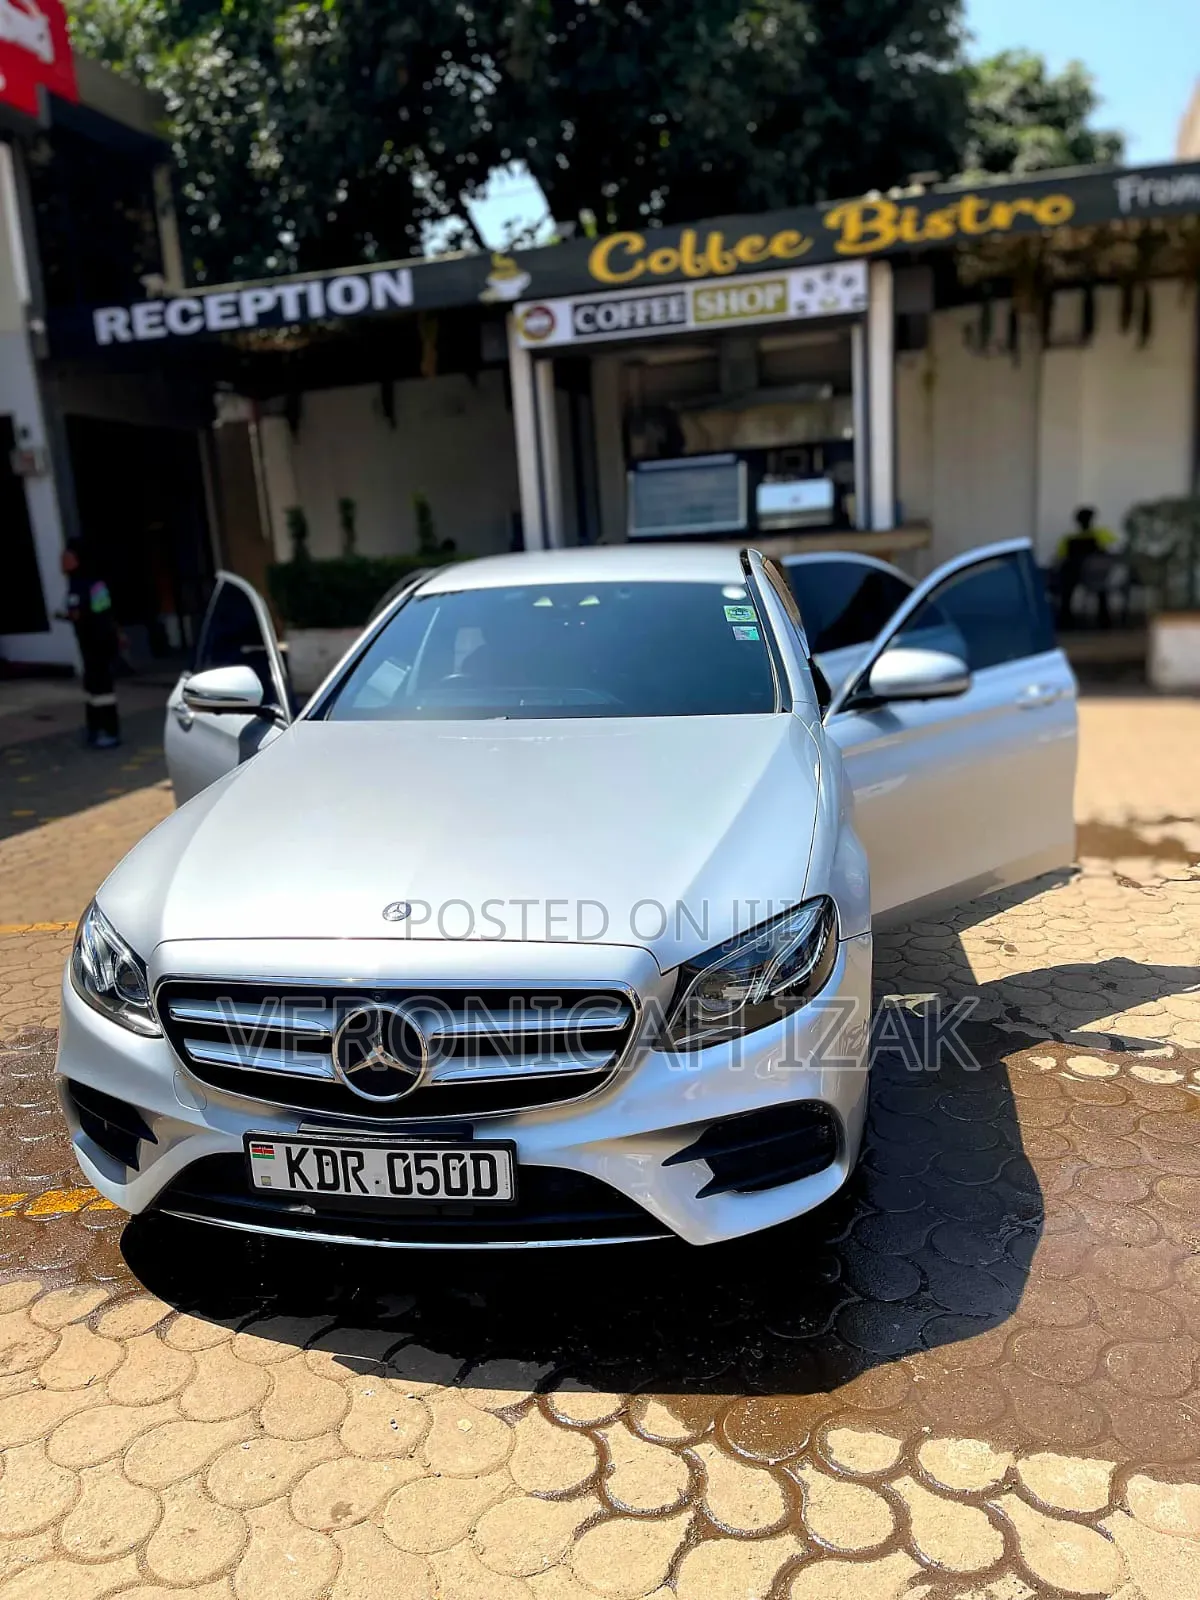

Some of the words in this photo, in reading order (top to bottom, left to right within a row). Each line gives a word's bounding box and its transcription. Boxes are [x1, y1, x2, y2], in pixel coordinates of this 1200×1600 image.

[823, 195, 1075, 254] Bistro
[93, 268, 413, 344] RECEPTION
[574, 292, 686, 334] COFFEE
[695, 282, 784, 322] SHOP
[285, 1146, 370, 1194] KDR
